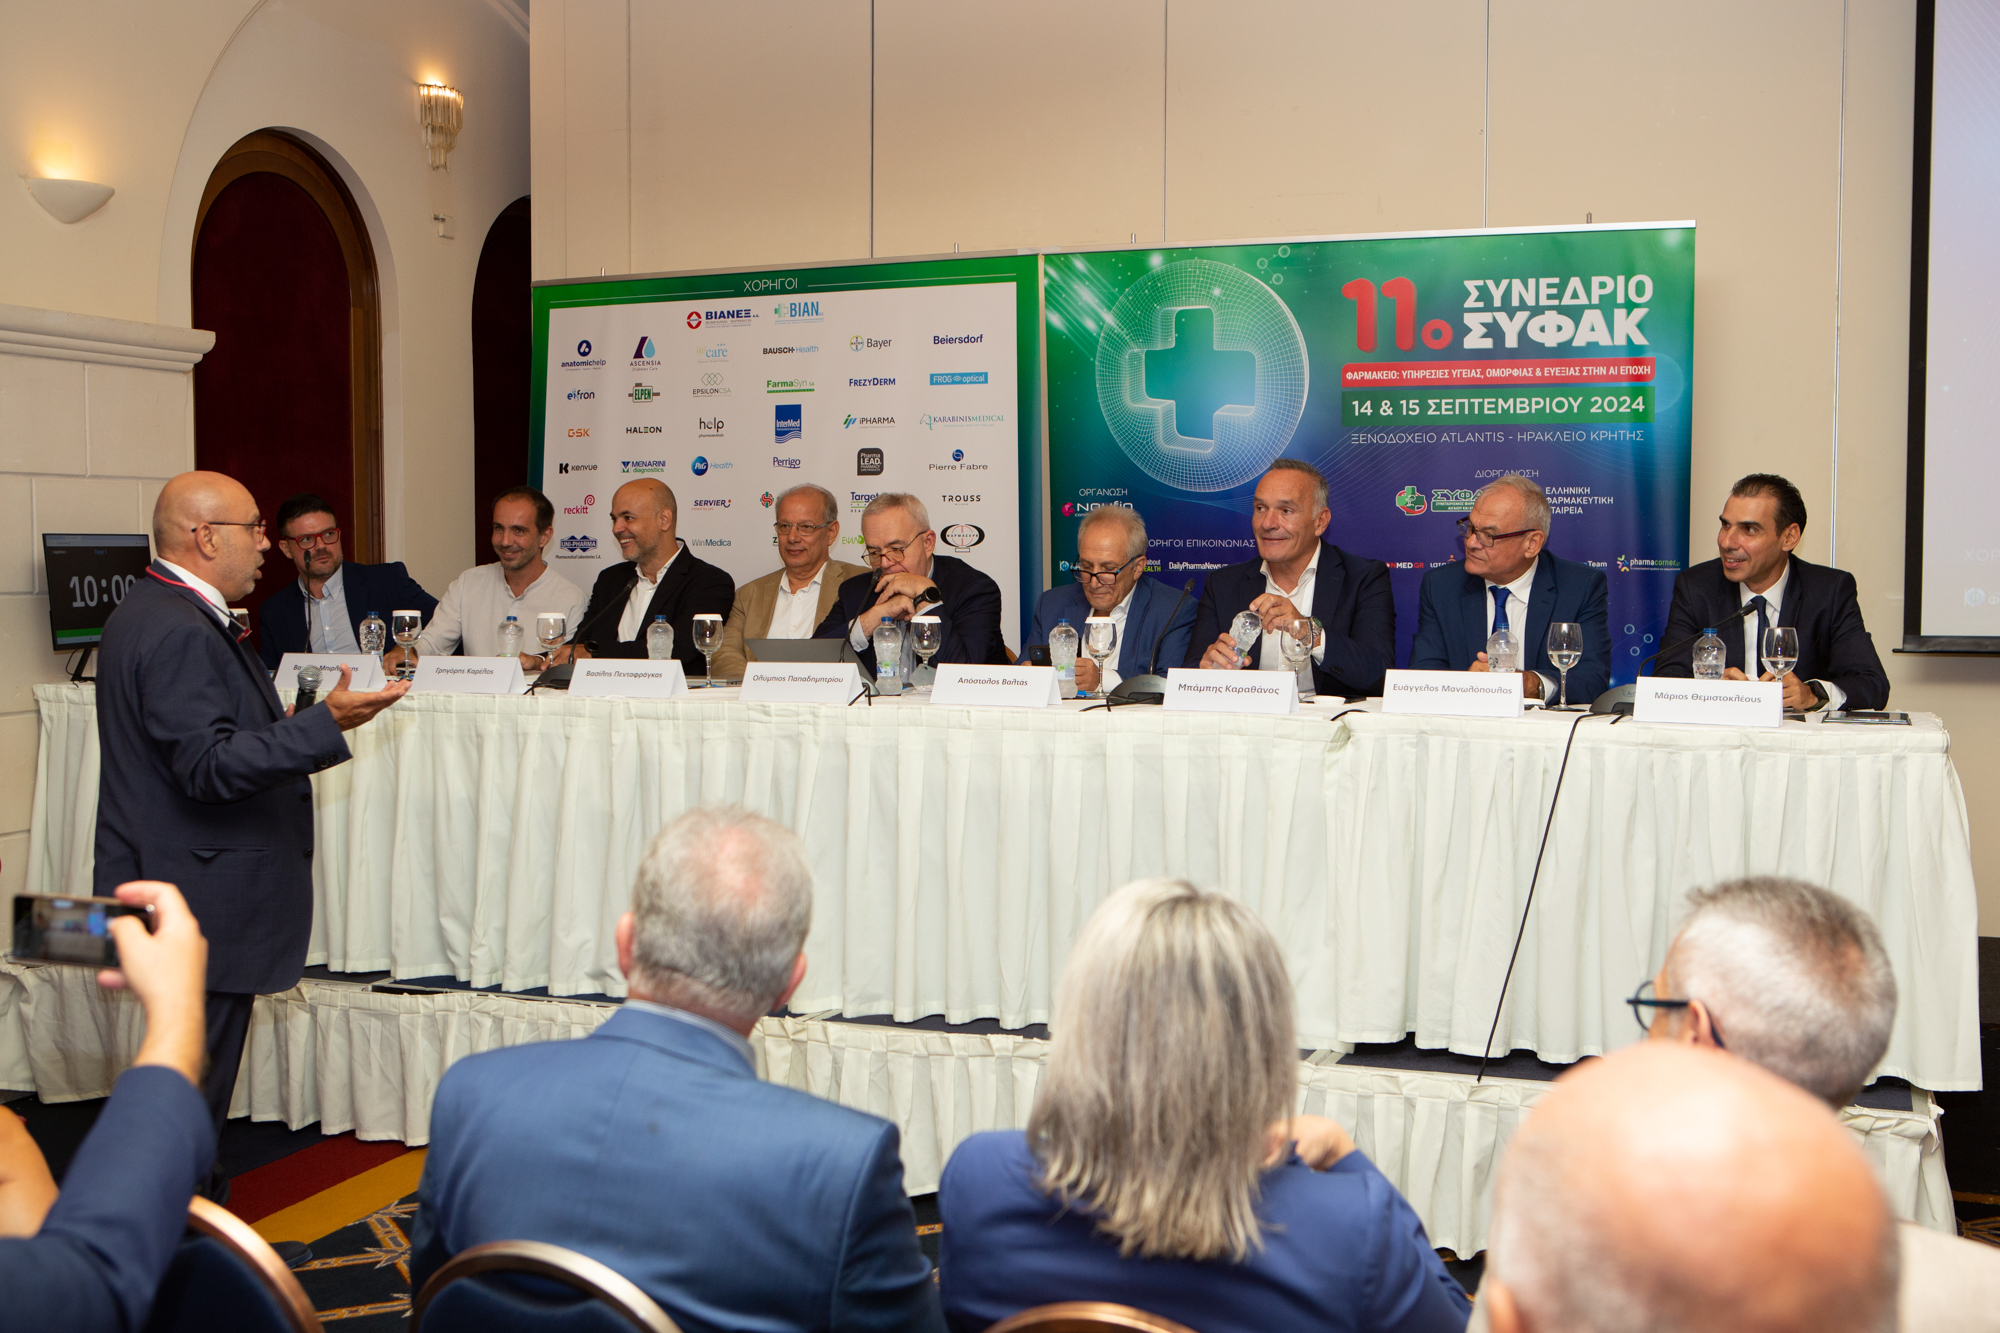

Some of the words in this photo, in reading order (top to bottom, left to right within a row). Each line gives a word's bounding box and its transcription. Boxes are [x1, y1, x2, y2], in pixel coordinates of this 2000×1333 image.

[744, 278, 798, 292] ΧΟΡΗΓΟΙ
[1463, 274, 1654, 308] ΣΥΝΕΔΡΙΟ
[1463, 308, 1650, 349] ΣΥΦΑΚ
[866, 338, 892, 350] Bayer
[933, 334, 983, 345] Beiersdorf
[561, 359, 606, 367] anatomichelp
[1346, 370, 1399, 380] ΦΑΡΜΑΚΕΙΟ:
[1402, 370, 1449, 379] ΥΠΗΡΕΣΙΕΣ
[1452, 369, 1484, 379] ΥΓΕΙΑΣ,
[1486, 368, 1533, 377] ΟΜΟΡΦΙΑΣ
[1536, 368, 1542, 376] &
[1544, 367, 1580, 376] ΕΥΕΞΙΑΣ
[1582, 366, 1606, 375] ΣΤΗΝ
[1620, 366, 1650, 375] ΕΠΟΧΗ
[767, 379, 807, 388] FarmaSyn
[933, 375, 952, 383] FROG
[962, 374, 985, 384] optical
[634, 388, 651, 400] ELPEN
[1352, 400, 1373, 416] 14
[1380, 400, 1393, 416] &
[1400, 400, 1420, 415] 15
[1427, 397, 1583, 415] ΣΕΠΤΕΜΒΡΙΟΥ
[1590, 396, 1645, 413] 2024
[699, 417, 724, 432] help
[776, 419, 800, 427] InterMed
[568, 428, 590, 438] GSK
[1351, 433, 1436, 444] ΞΕΝΟΔΟΧΕΙΟ
[1518, 431, 1586, 442] ΗΡΑΚΛΕΙΟ
[1591, 431, 1644, 441] ΚΡΗΤΗΣ
[773, 457, 800, 468] Perrigo
[1432, 490, 1482, 500] ΣΥΦΑ
[564, 505, 588, 514] reckitt
[614, 671, 662, 679] Πενταφράγκας
[752, 674, 786, 683] Ολύμπιος
[788, 675, 843, 684] Παπαδημητρίου
[1178, 684, 1223, 693] Μπάμπης
[1225, 685, 1280, 695] Καραθάνος
[1393, 683, 1439, 692] Ευάγγελος
[1441, 685, 1512, 694] Μανωλόπουλος
[1654, 692, 1688, 701] Μάριος
[1691, 693, 1762, 703] Θεμιστοκλέους
